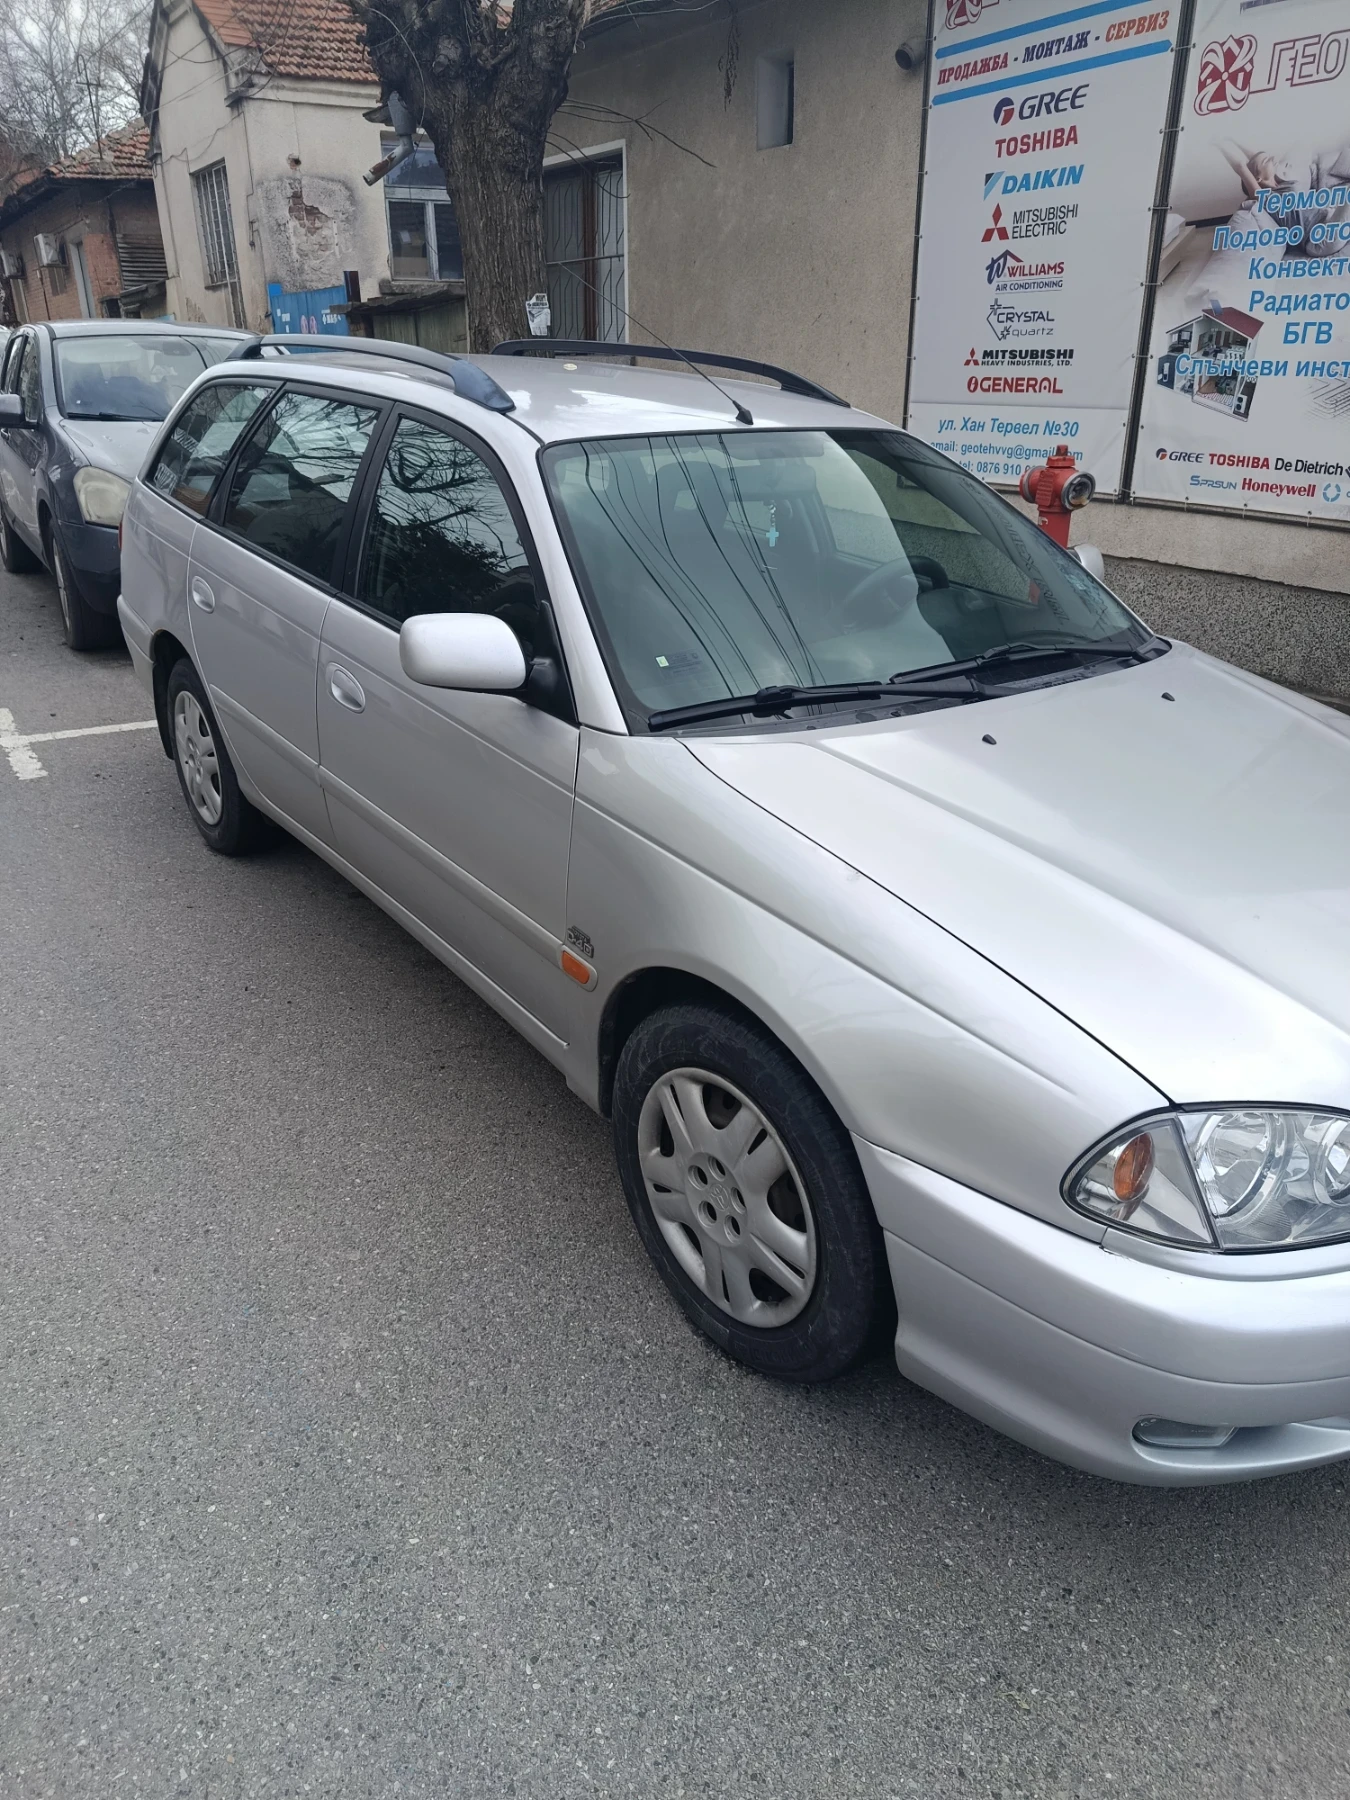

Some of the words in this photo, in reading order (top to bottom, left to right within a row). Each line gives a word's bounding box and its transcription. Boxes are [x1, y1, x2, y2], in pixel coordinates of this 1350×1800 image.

[937, 52, 1009, 85] ПРОДАЖБА
[1022, 31, 1092, 64] МОНТАЖ
[1105, 10, 1170, 43] СЕРВИЗ
[1018, 83, 1090, 121] GREE
[995, 125, 1079, 158] TOSHIBA
[1001, 164, 1085, 195] DAIKIN
[1255, 186, 1350, 219] Термоп
[1012, 203, 1079, 225] MITSUBISHI
[1012, 220, 1067, 239] ELECTRIC
[1212, 225, 1304, 252] Подово
[1007, 261, 1065, 278] WILLIAMS
[1248, 256, 1350, 280] Конвект
[995, 283, 1008, 292] AIR
[1009, 280, 1063, 291] CONDITIONING
[1248, 290, 1350, 316] Радиато
[996, 310, 1055, 323] CRYSTAL
[1012, 327, 1054, 337] quartz
[1283, 321, 1333, 344] БГВ
[982, 349, 1074, 360] MITSUBISHI
[1007, 359, 1054, 367] INDUSTRIES,
[1175, 353, 1288, 377] Слънчеви
[979, 376, 1064, 394] GENERAL
[938, 418, 957, 434] ул.
[960, 416, 986, 432] Хан
[990, 417, 1040, 437] Тервел
[1042, 420, 1080, 437] №30
[976, 461, 1000, 474] 0876
[1003, 463, 1021, 476] 910
[1168, 451, 1205, 464] GREE
[1208, 453, 1270, 470] TOSHIBA
[1274, 457, 1293, 472] De
[1294, 459, 1344, 476] Dietrich
[1241, 477, 1316, 498] Honeywell
